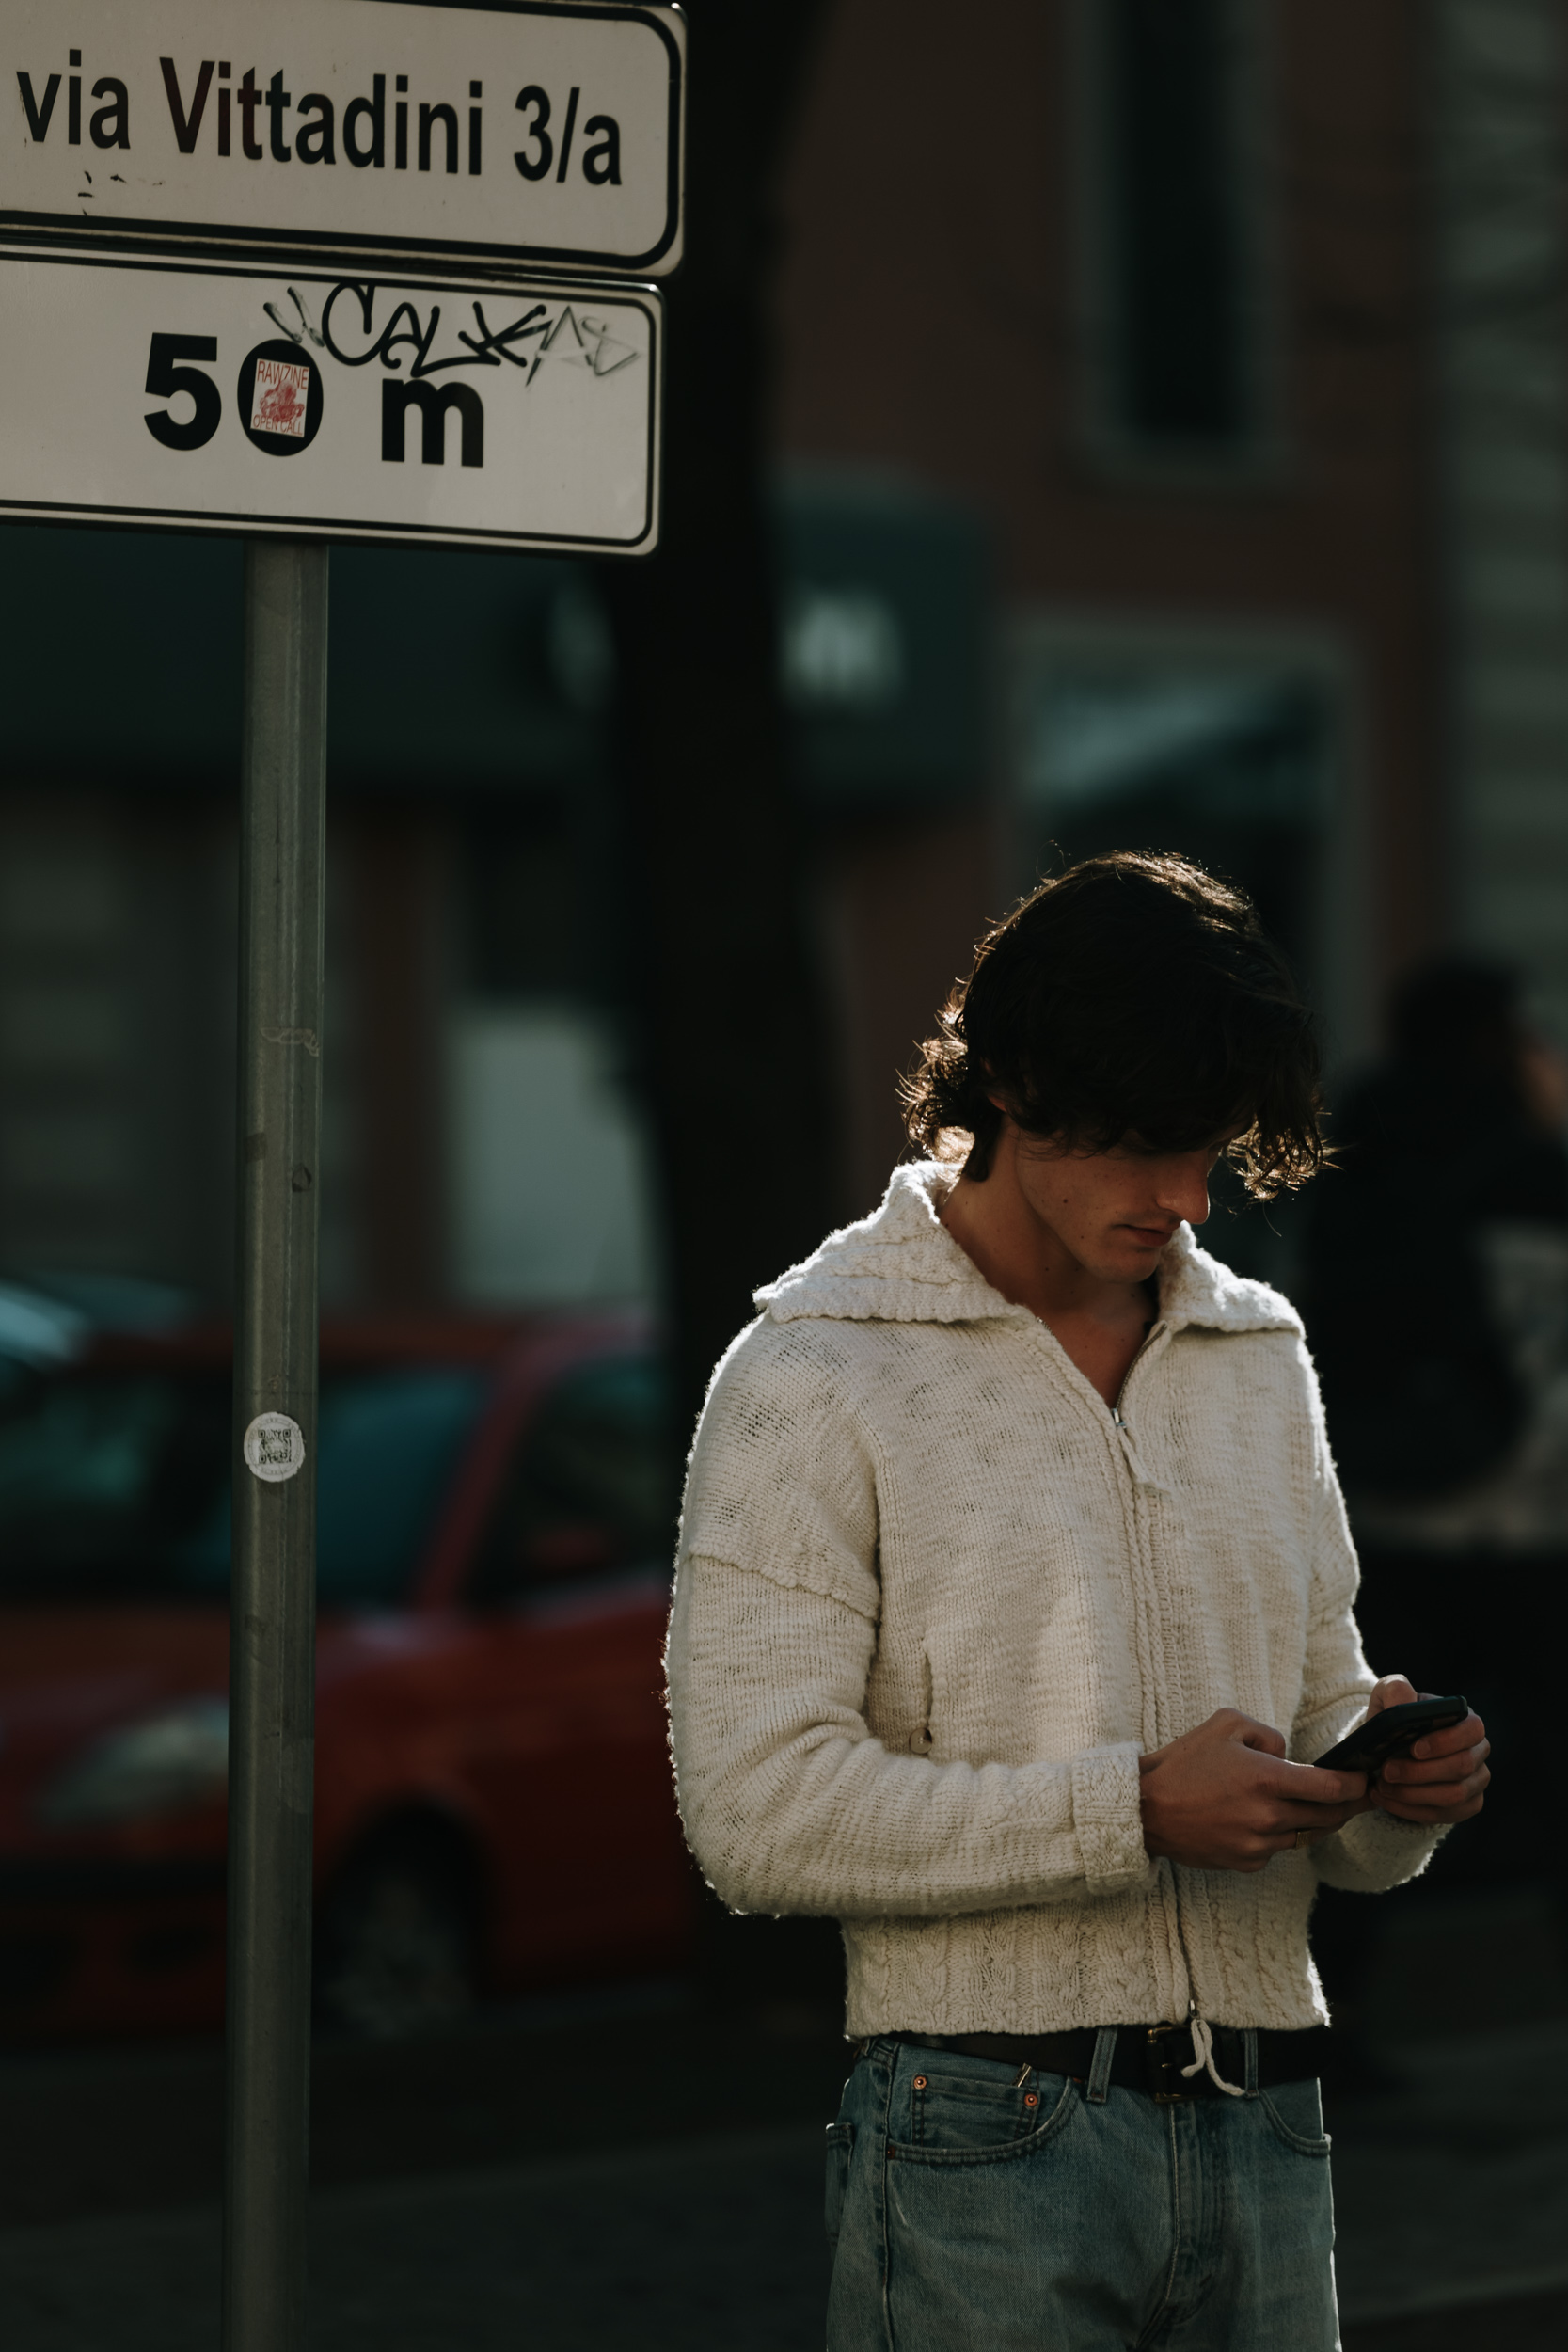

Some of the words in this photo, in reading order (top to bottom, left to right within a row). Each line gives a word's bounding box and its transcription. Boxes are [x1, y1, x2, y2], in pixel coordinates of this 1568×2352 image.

[16, 50, 130, 150] via
[159, 57, 482, 176] Vittadini
[514, 86, 622, 185] 3/a
[144, 333, 324, 457] 50
[381, 378, 483, 468] m
[279, 421, 304, 436] CALL
